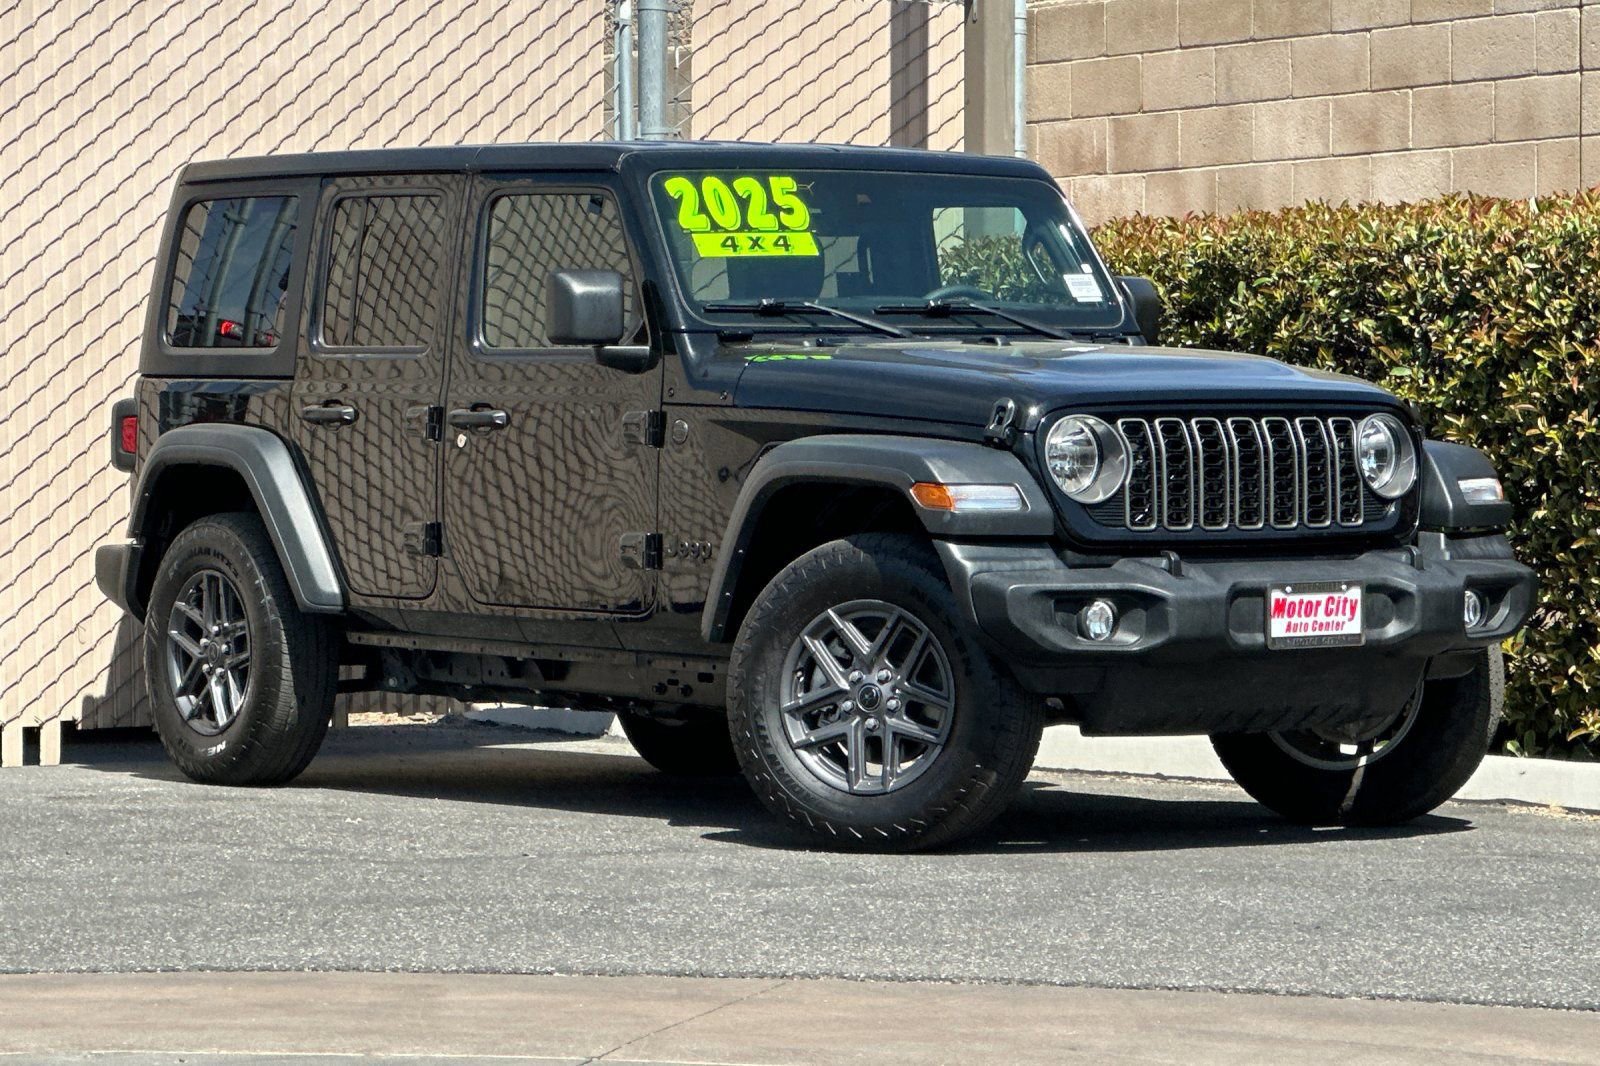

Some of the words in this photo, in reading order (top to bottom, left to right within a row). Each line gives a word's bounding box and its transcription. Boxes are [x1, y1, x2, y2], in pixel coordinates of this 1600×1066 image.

[664, 176, 810, 231] 2025
[665, 534, 712, 562] Jeep
[1271, 597, 1322, 619] Motor
[1324, 595, 1358, 622] City
[1285, 621, 1309, 633] Auto
[1311, 620, 1345, 632] Center
